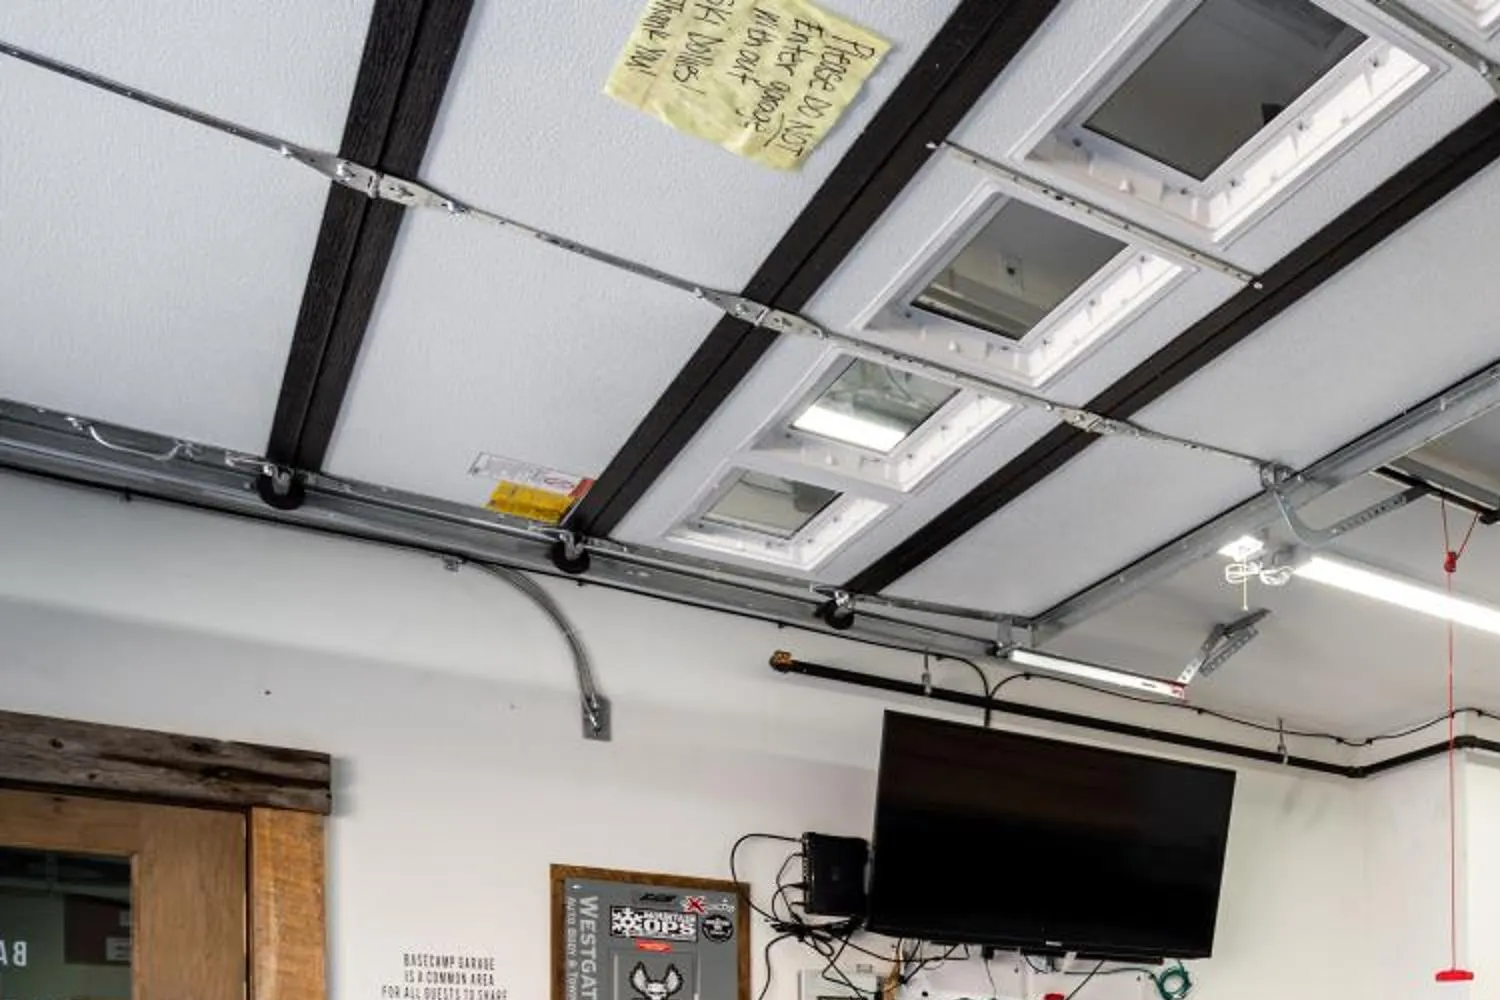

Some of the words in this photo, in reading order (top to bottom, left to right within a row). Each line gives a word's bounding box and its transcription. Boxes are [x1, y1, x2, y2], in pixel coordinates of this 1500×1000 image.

[775, 18, 824, 77] Enter
[809, 35, 876, 92] Please
[776, 119, 816, 156] NOT
[643, 920, 696, 936] OPS
[403, 953, 455, 968] BASECAMP
[426, 971, 467, 985] COMMON
[470, 973, 494, 987] AREA
[382, 985, 400, 999] FOR
[403, 986, 421, 1000] ALL
